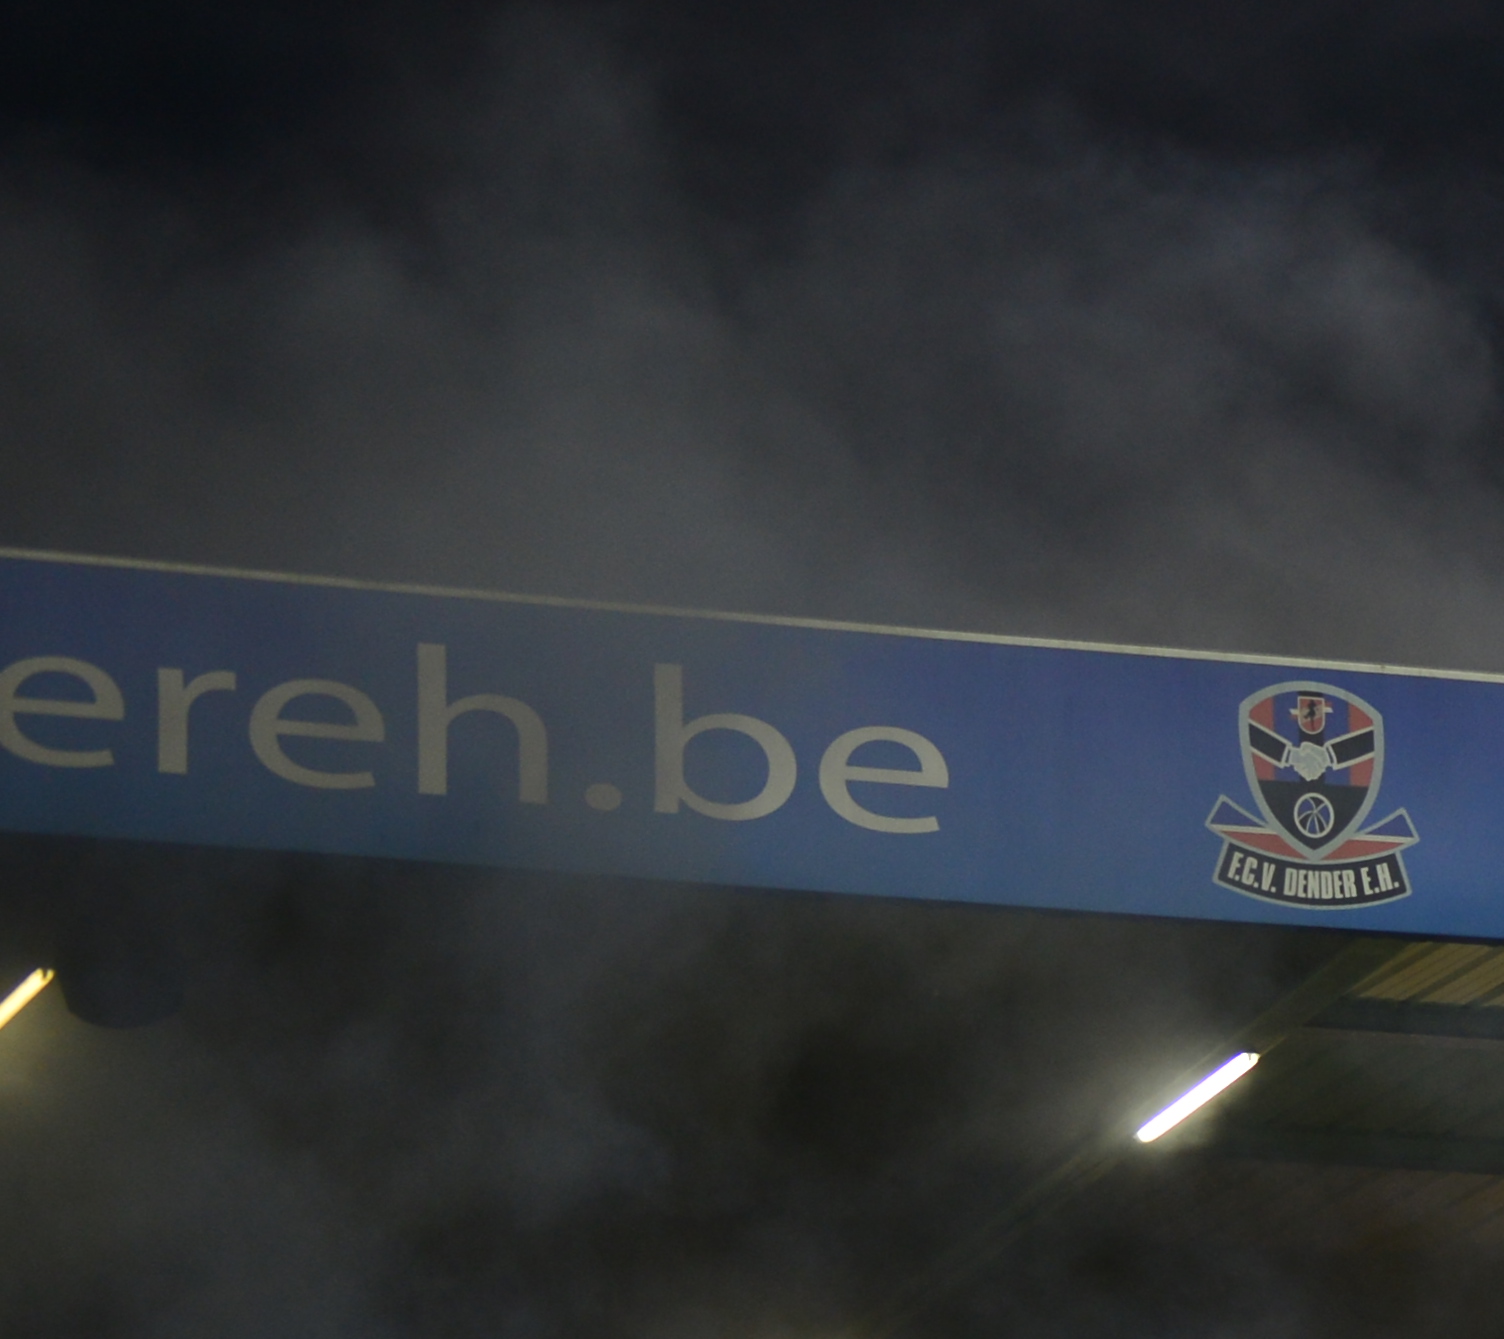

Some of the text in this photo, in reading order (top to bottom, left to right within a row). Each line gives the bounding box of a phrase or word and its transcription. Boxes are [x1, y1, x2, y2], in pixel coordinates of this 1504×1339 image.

[1227, 851, 1400, 899] F.C.V. DENDER E.H.
